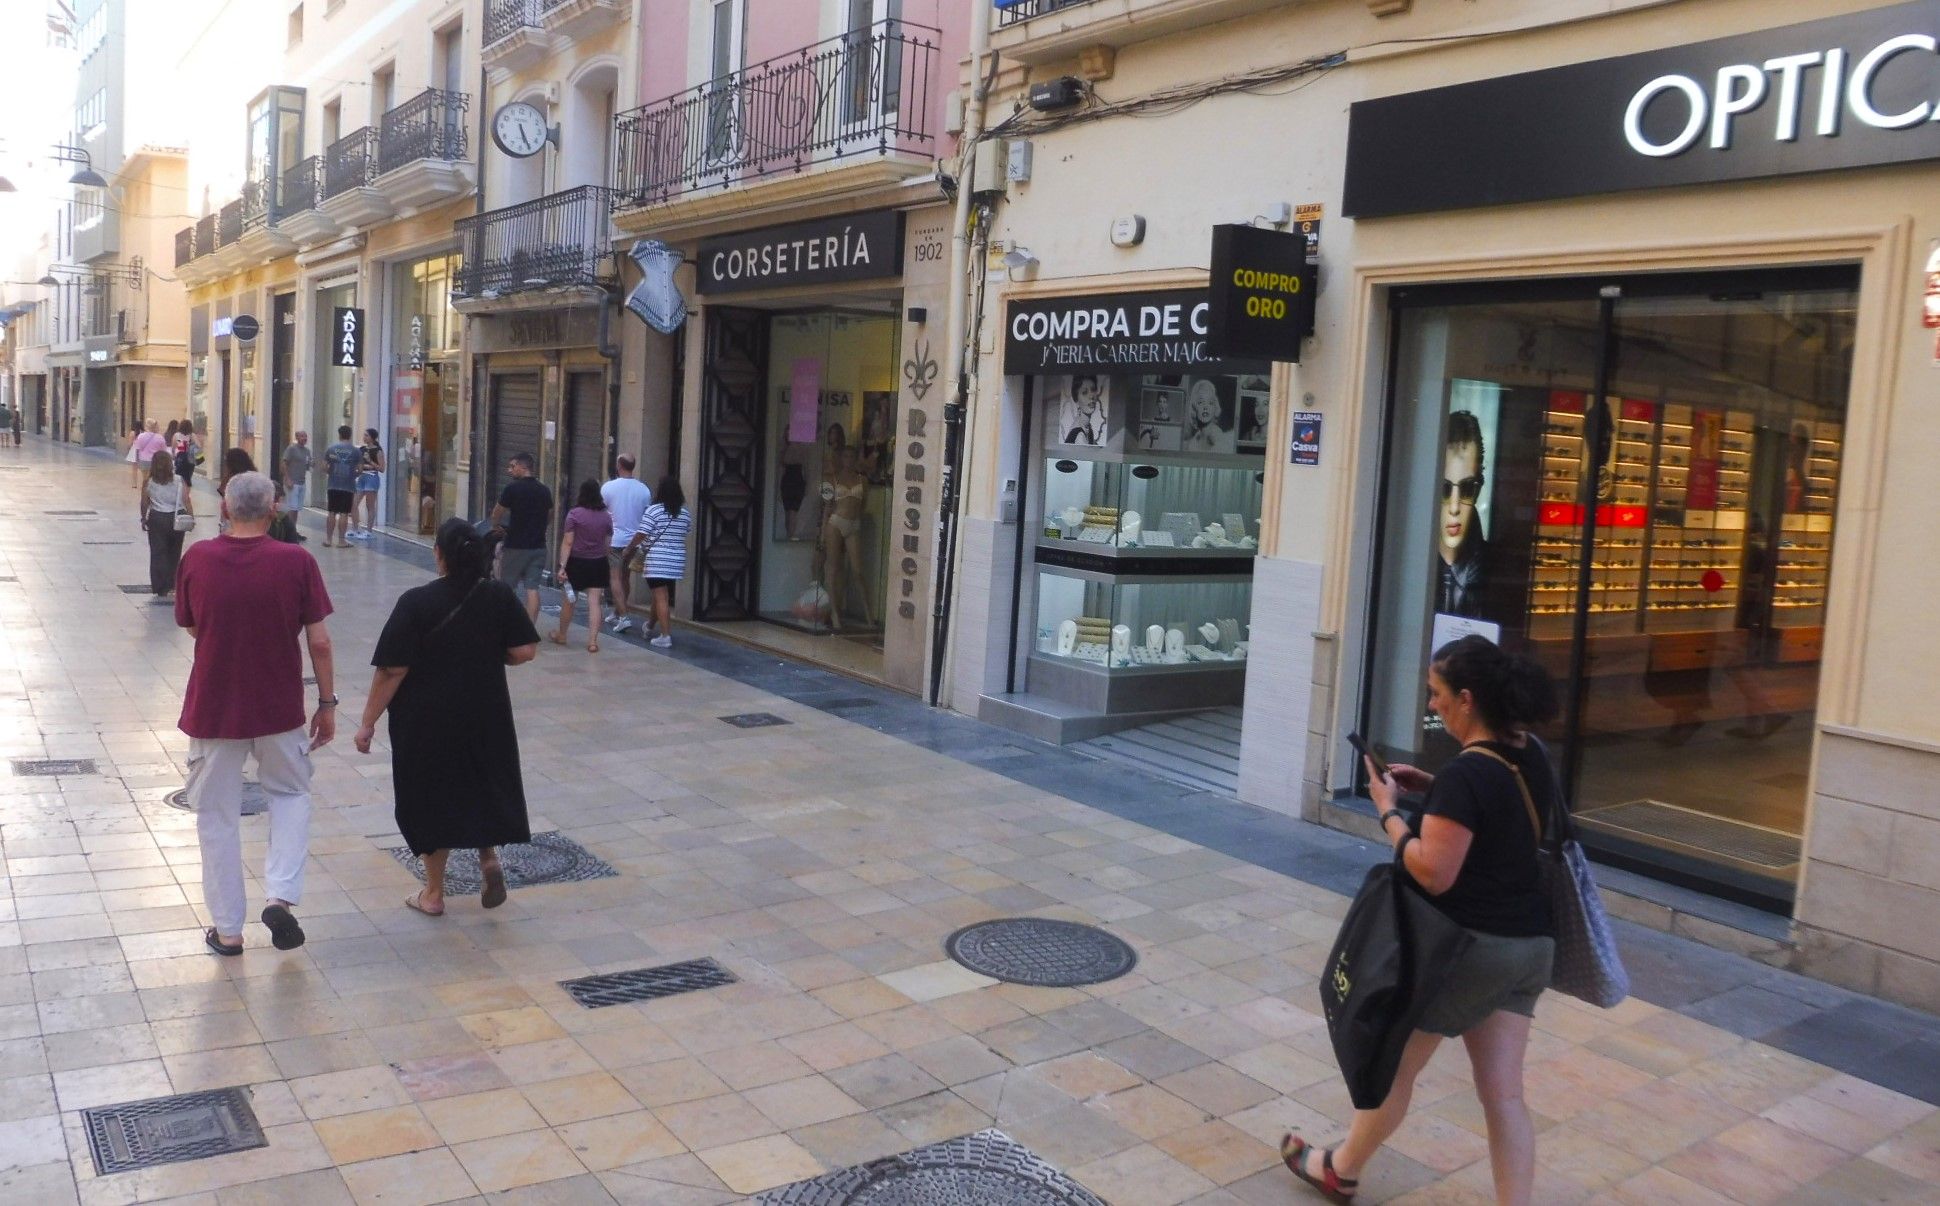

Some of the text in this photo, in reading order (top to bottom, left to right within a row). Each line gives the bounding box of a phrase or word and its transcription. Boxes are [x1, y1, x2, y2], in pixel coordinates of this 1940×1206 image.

[1624, 34, 1940, 157] OPTIC
[713, 226, 870, 281] CORSETERÍA
[914, 242, 943, 262] 1902
[1233, 267, 1300, 294] COMPRO
[1246, 296, 1285, 320] ORO
[1012, 307, 1130, 342] COMPRA
[1139, 304, 1181, 336] DE
[341, 310, 356, 364] ADANA
[1294, 413, 1321, 421] ALARMA
[1292, 441, 1318, 452] Casva
